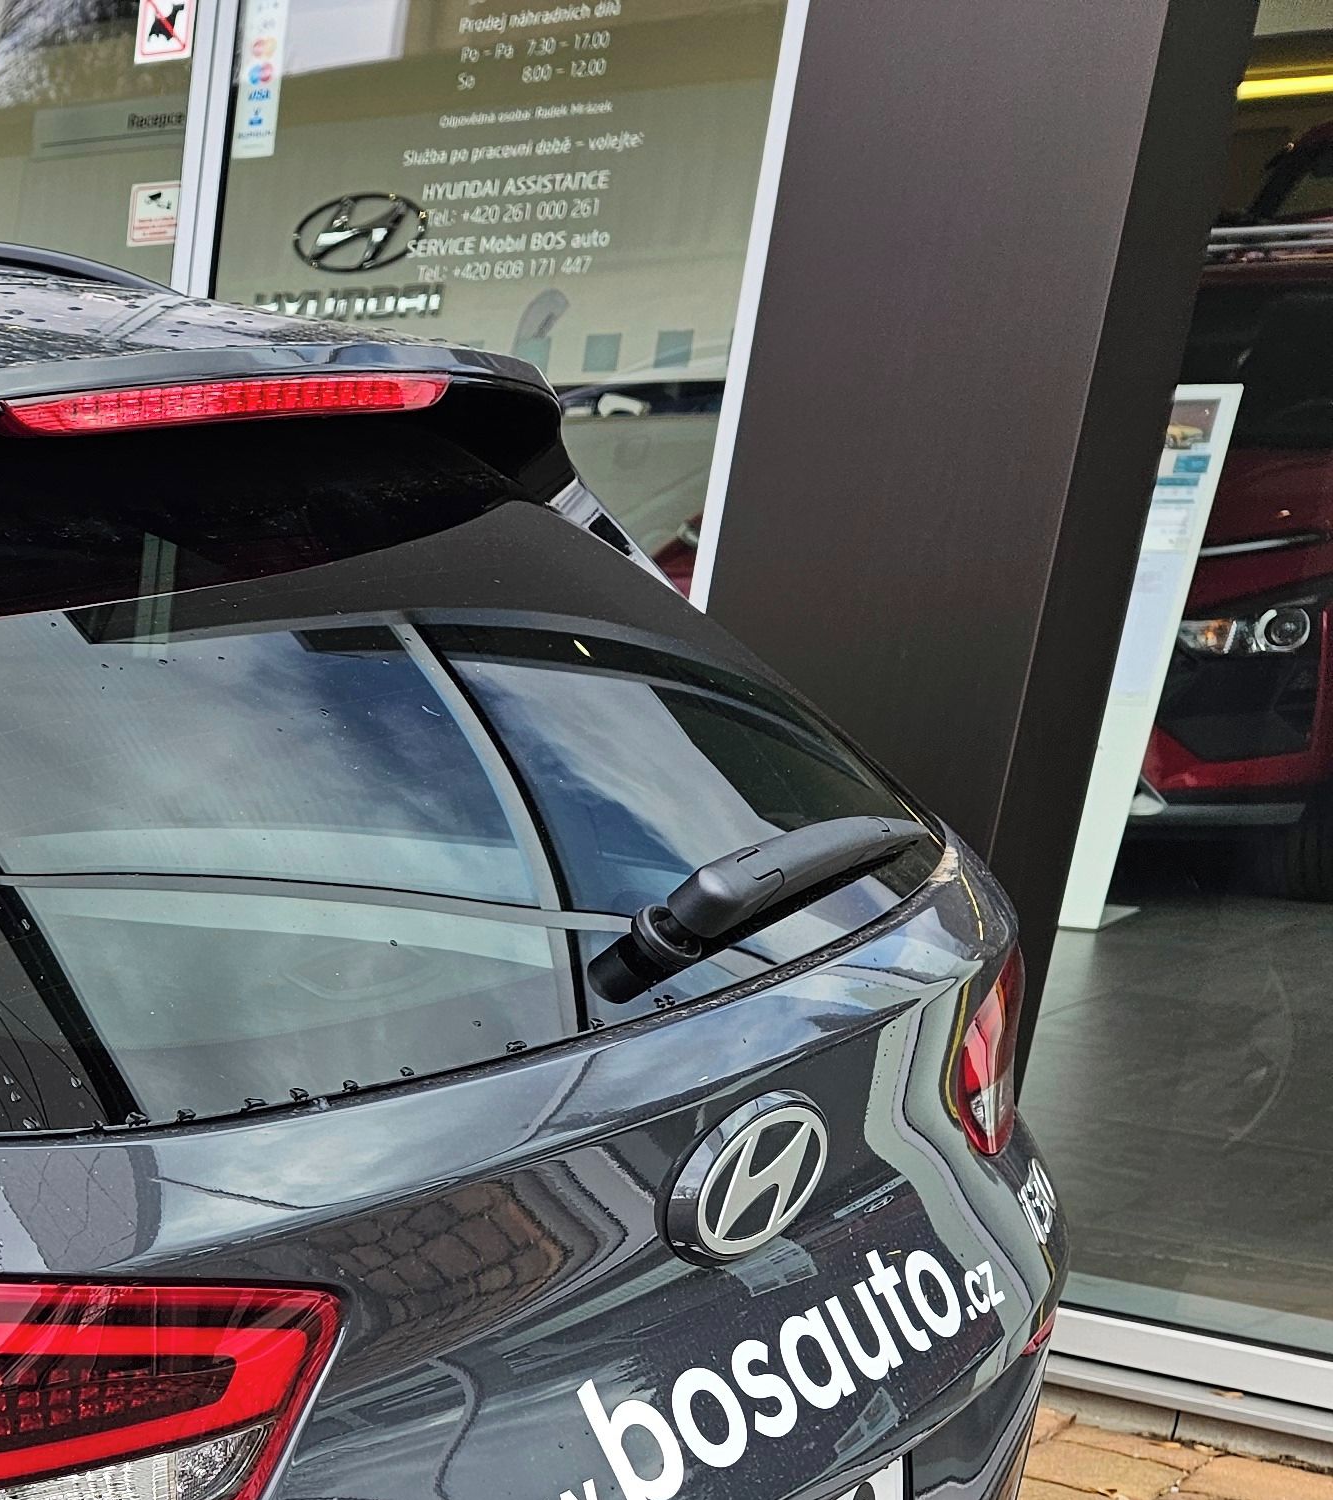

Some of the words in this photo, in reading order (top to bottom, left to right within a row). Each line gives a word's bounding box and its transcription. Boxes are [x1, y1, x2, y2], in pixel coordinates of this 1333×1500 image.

[459, 13, 507, 33] Prodej
[460, 47, 479, 63] Po
[574, 31, 610, 49] 17.00
[457, 72, 475, 91] So
[571, 58, 607, 78] 12.00
[403, 149, 447, 166] Služba
[450, 150, 467, 165] po
[423, 179, 499, 201] HYUNDAI
[503, 169, 611, 196] ASSISTANCE
[462, 205, 500, 224] +420
[503, 203, 531, 222] 261
[537, 200, 568, 220] 000
[571, 198, 599, 217] 261
[406, 237, 476, 258] SERVICE
[480, 234, 526, 253] Mobil
[530, 231, 566, 250] BOS
[571, 229, 610, 248] auto
[453, 261, 490, 281] +420
[530, 258, 555, 277] 171
[561, 256, 592, 274] 447
